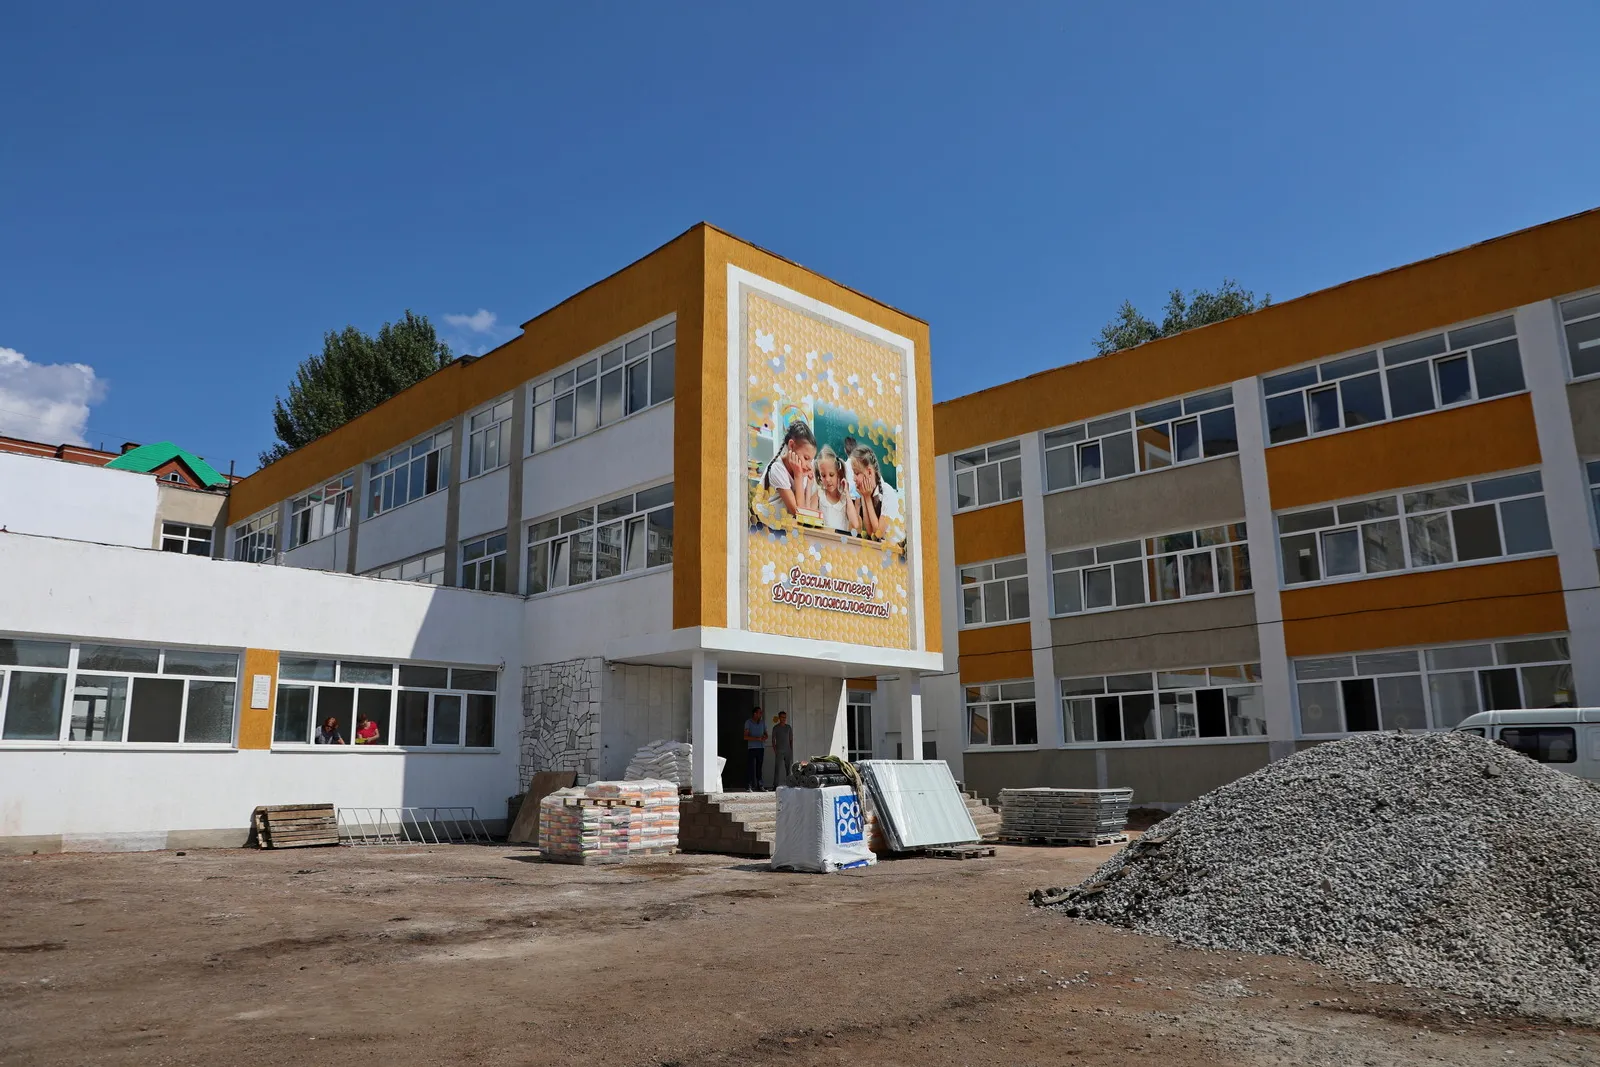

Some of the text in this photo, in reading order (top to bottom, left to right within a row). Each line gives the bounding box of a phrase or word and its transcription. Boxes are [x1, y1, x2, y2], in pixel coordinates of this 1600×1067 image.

[773, 583, 890, 616] Добро пожаловать!
[836, 796, 860, 820] ico
